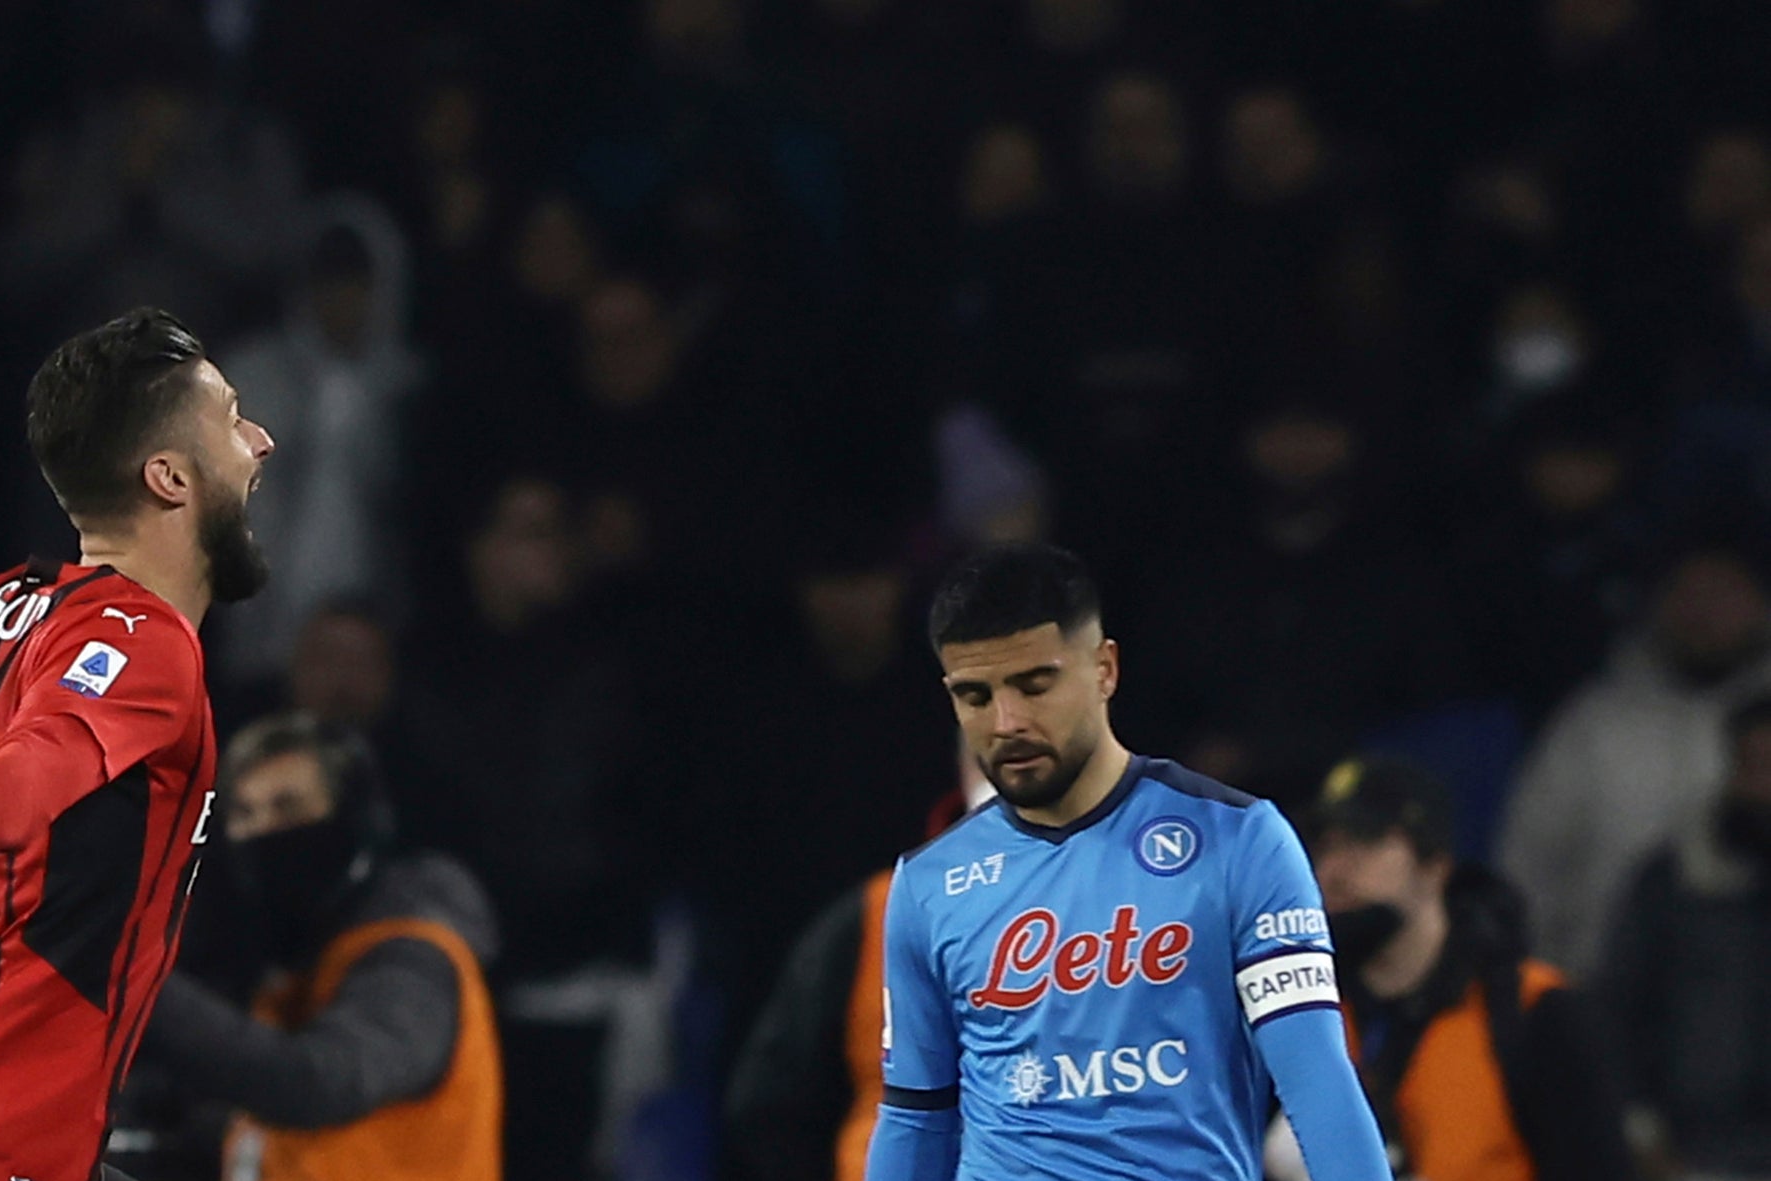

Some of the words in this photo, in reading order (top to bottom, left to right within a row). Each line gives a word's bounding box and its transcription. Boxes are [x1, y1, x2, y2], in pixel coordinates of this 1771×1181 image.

[945, 852, 1006, 896] EA7
[1255, 907, 1329, 940] ama
[968, 904, 1193, 1010] Lete
[1053, 1039, 1189, 1100] MSC
